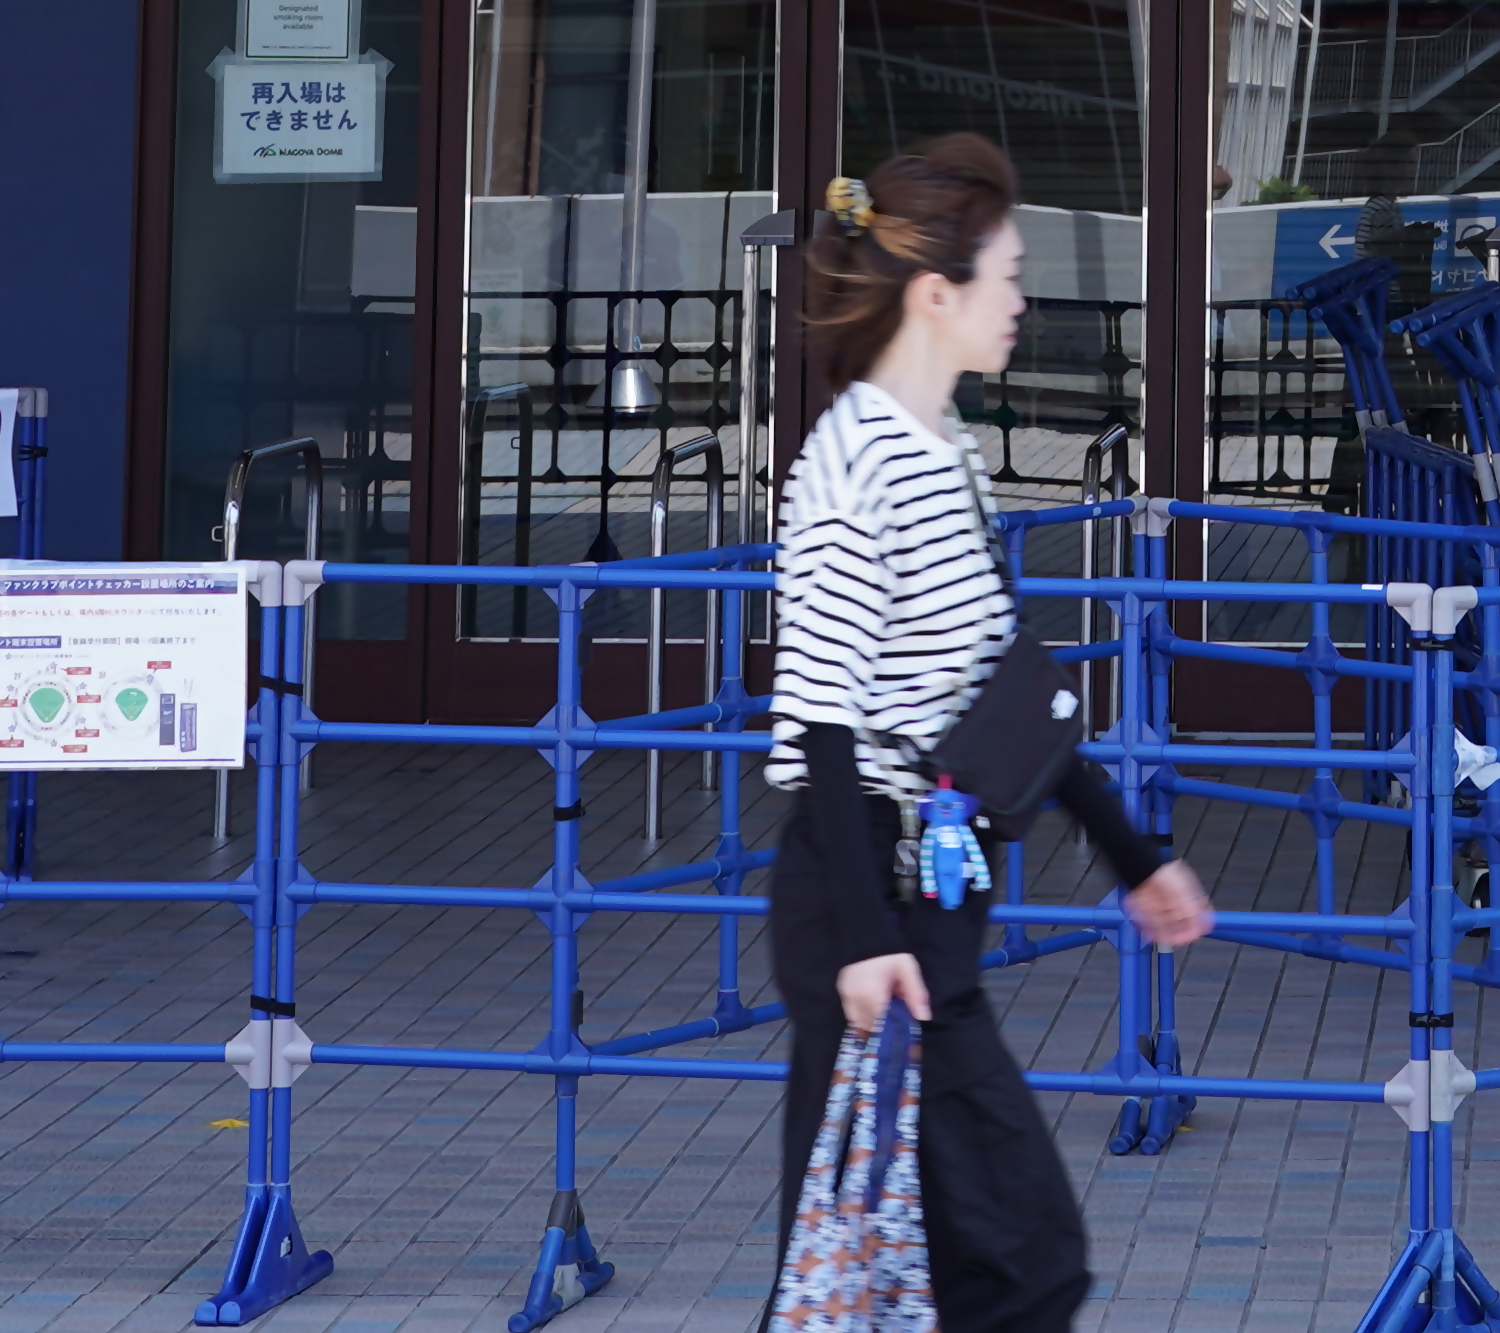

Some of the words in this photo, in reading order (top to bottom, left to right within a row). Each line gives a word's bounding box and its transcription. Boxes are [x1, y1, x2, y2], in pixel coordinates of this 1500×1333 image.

[251, 82, 346, 104] 再入場は
[240, 109, 358, 131] できません
[316, 147, 344, 157] DOME
